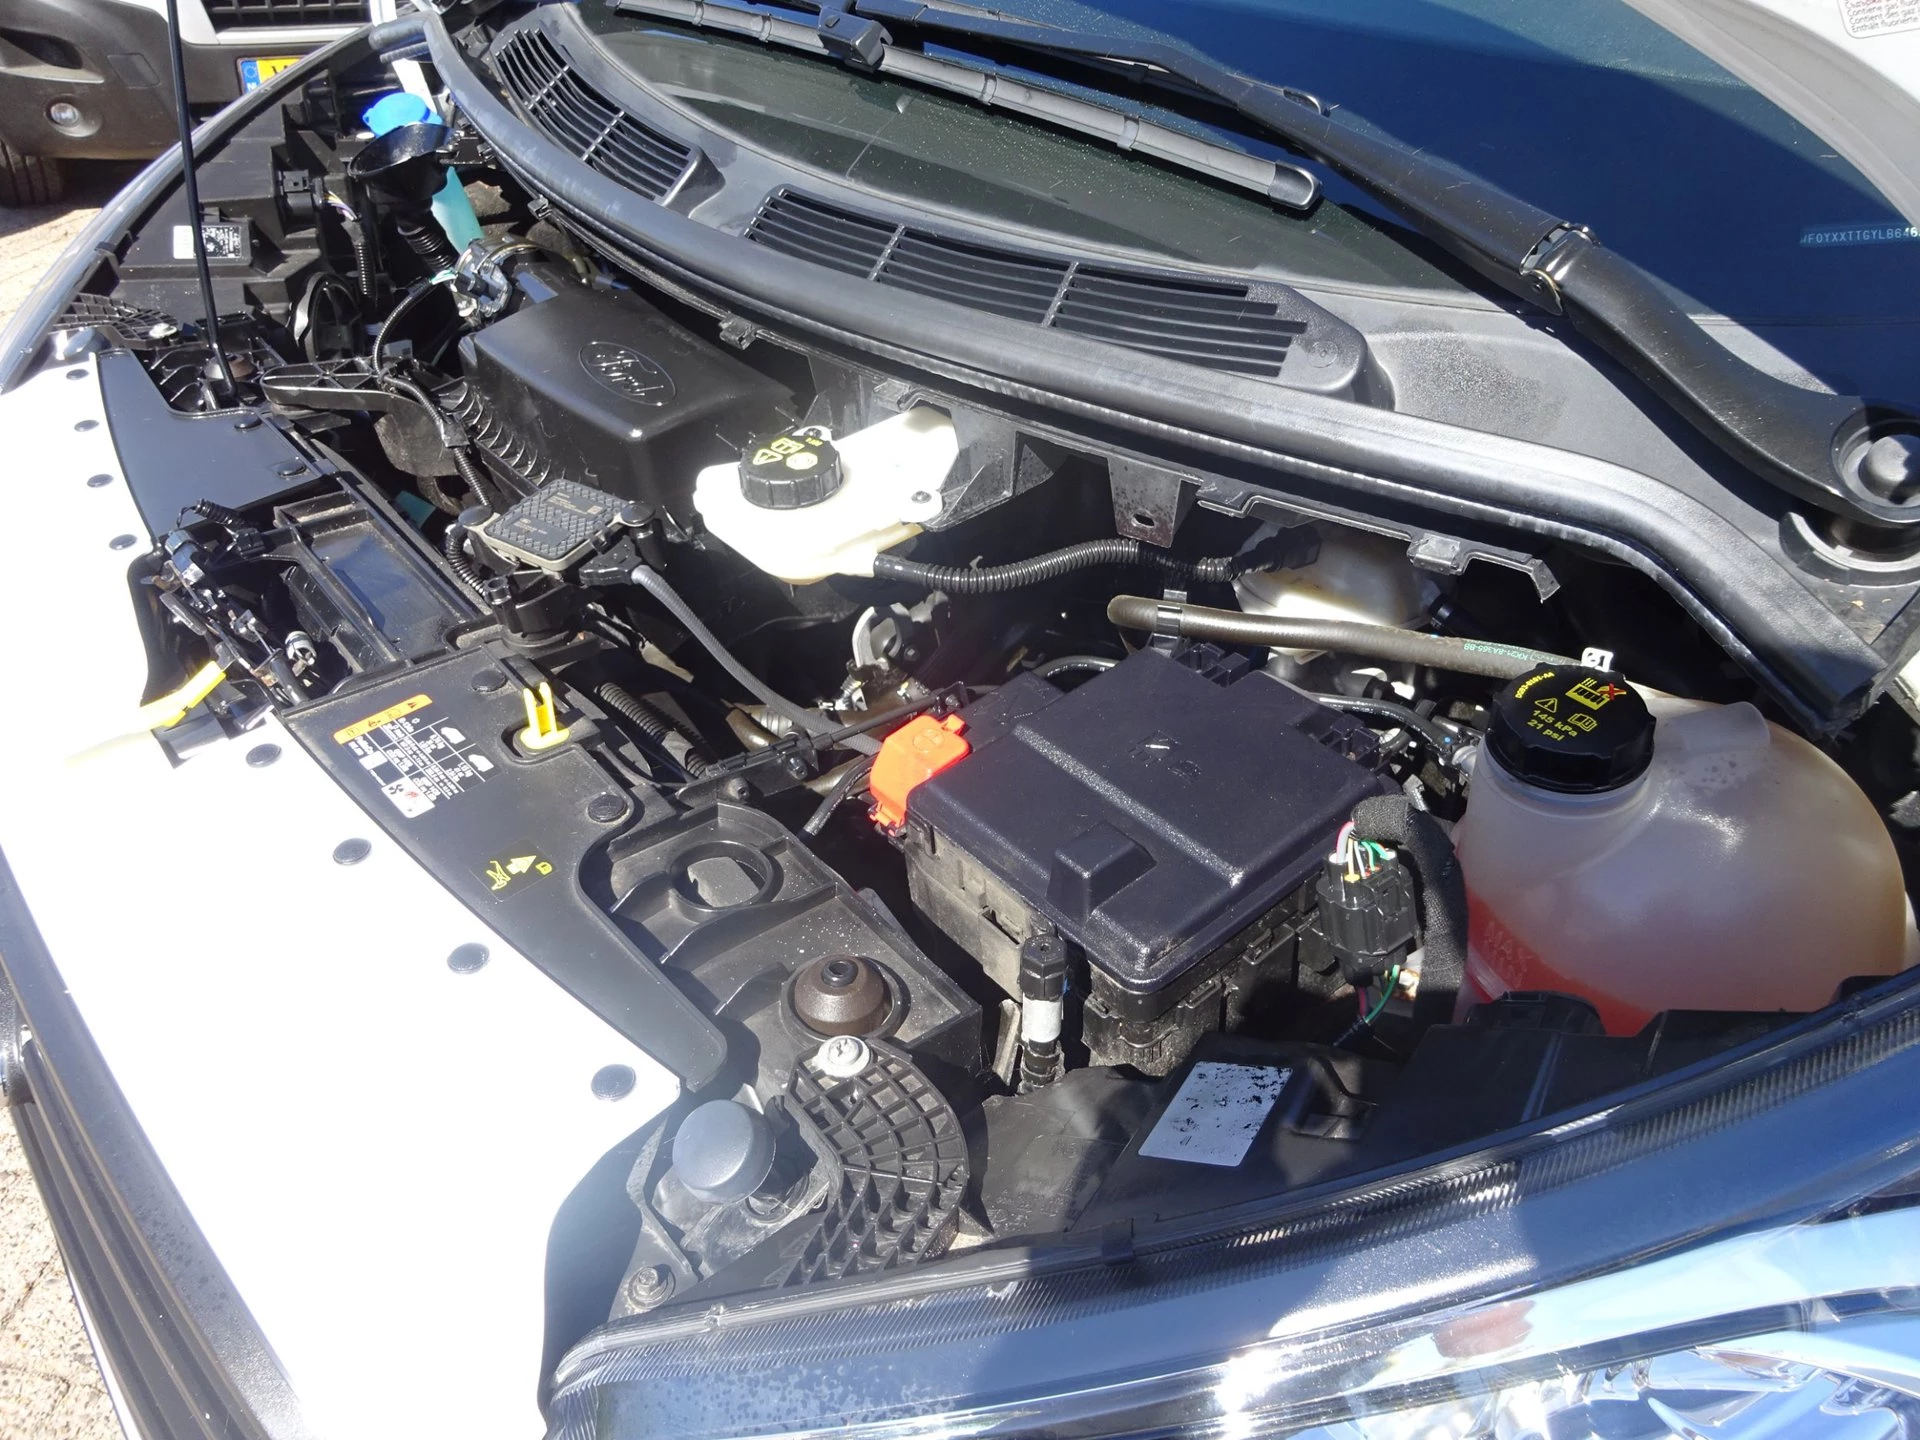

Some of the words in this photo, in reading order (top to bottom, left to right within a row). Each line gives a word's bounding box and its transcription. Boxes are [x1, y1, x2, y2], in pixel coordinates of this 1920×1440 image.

[585, 349, 665, 397] Ford
[1527, 718, 1542, 730] 21
[1542, 728, 1566, 742] psi
[1532, 709, 1554, 724] 145
[1554, 721, 1578, 738] kPa
